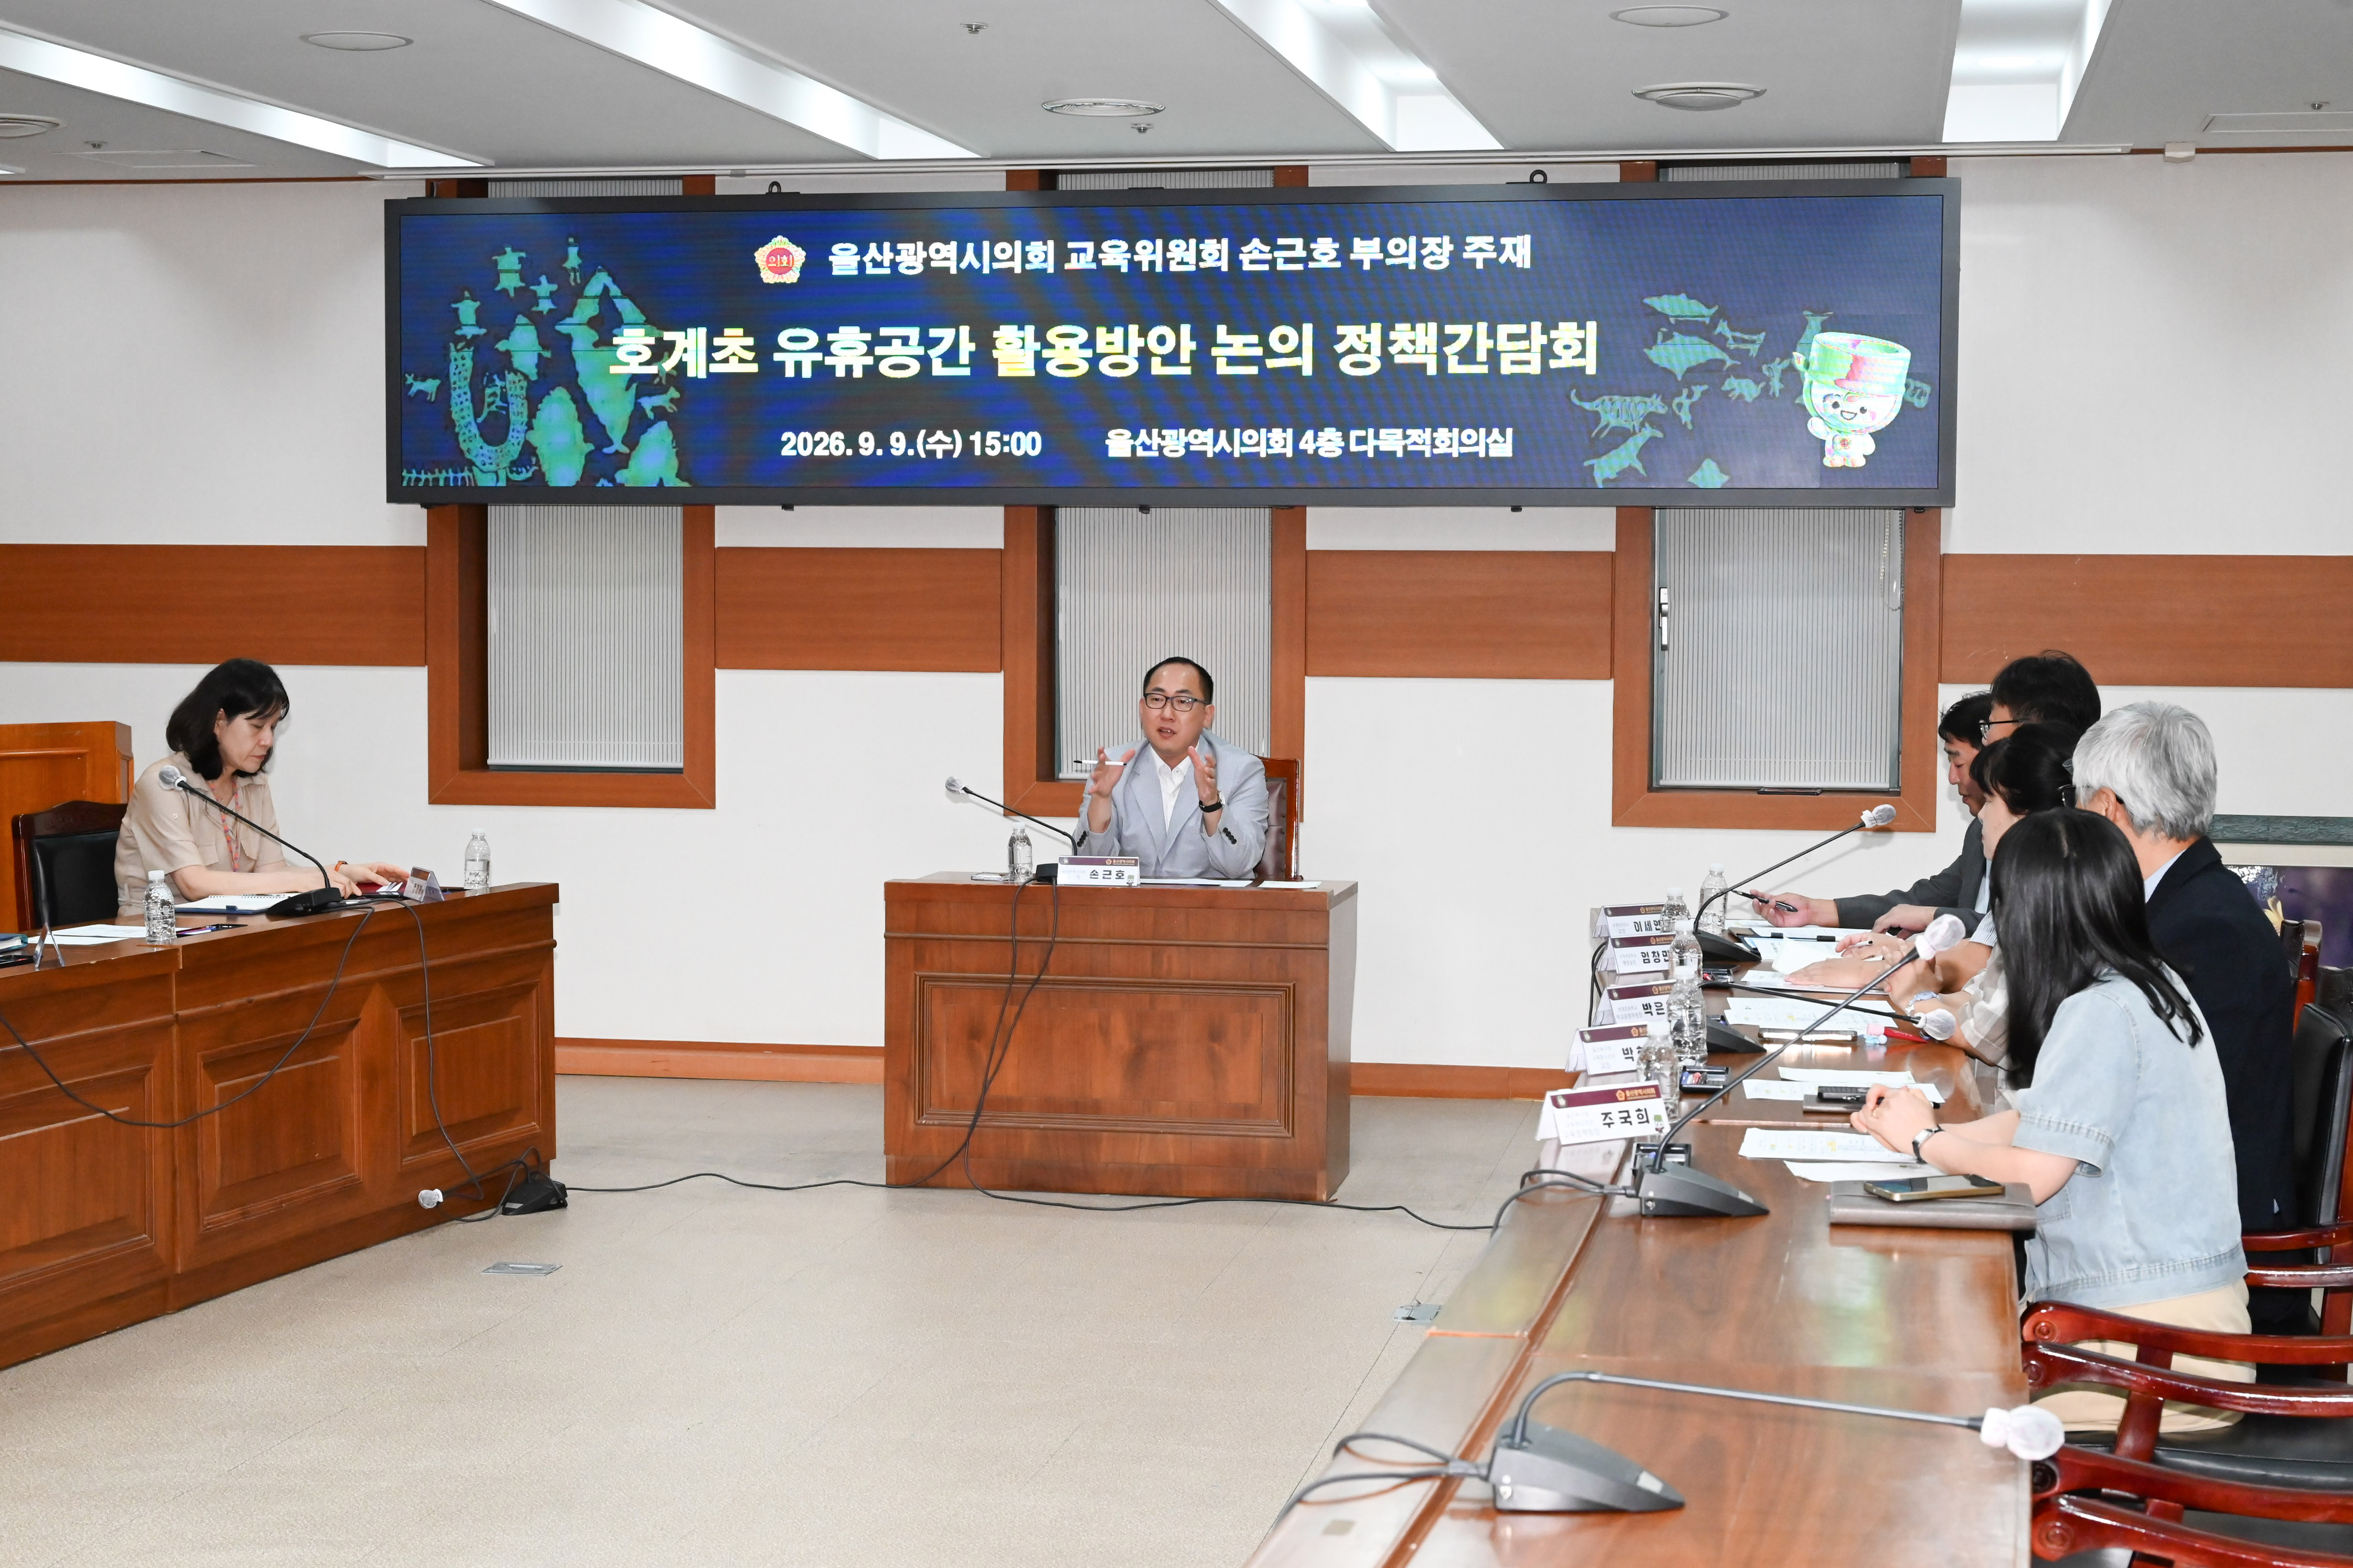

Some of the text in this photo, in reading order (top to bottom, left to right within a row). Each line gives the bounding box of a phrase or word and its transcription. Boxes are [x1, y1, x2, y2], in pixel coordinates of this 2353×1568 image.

[768, 254, 792, 267] 의회
[829, 234, 1531, 275] 울산광역시의회 교육위원회 손근호 부의장 주재
[609, 320, 1597, 379] 호계초 유휴공간 활용방안 논의 정책간담회
[781, 429, 1042, 459] 2026. 9. 9.(수) 15:00
[1105, 427, 1513, 458] 울산광역시의회 4층 다목적회의실
[1089, 870, 1125, 880] 손근호
[1642, 1002, 1665, 1016] 박은
[1601, 1107, 1650, 1128] 주국희
